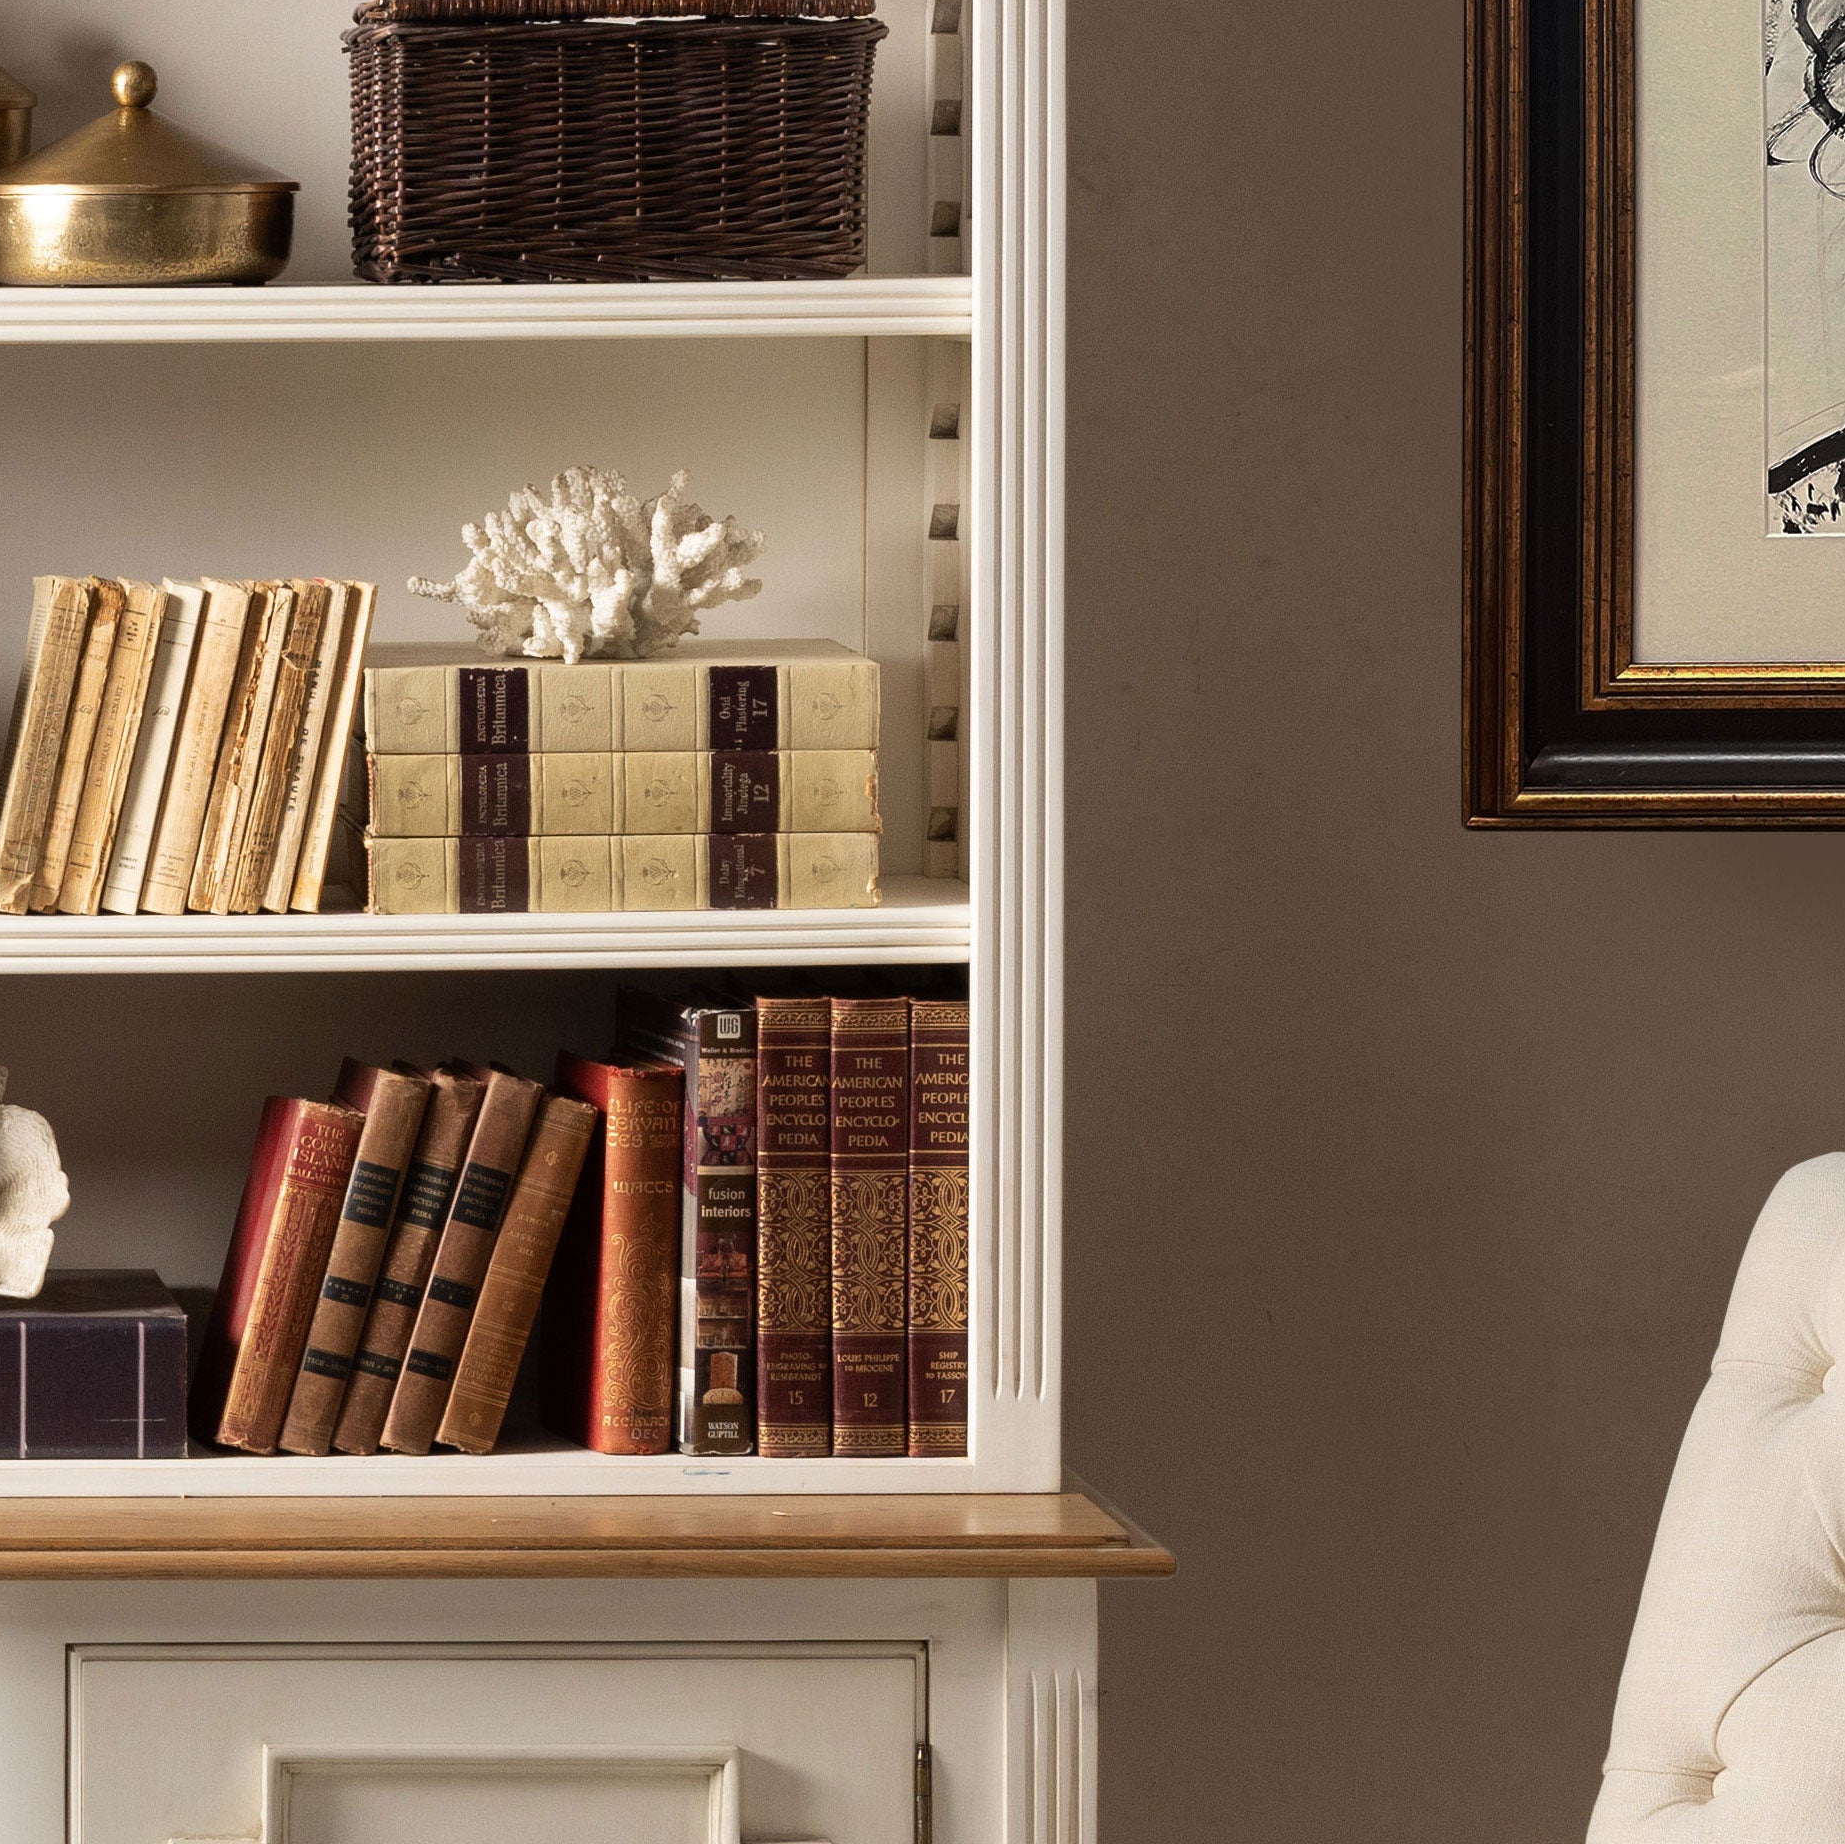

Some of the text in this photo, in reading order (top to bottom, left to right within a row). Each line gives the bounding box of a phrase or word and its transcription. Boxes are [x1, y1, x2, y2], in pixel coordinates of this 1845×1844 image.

[491, 673, 506, 745] Britannica
[719, 696, 731, 720] Ovid
[736, 681, 749, 732] Plastering
[753, 698, 768, 717] 17
[493, 762, 508, 826] Britannica
[721, 762, 735, 822] Immortality
[754, 784, 769, 802] 12
[491, 839, 506, 909] Britannica
[719, 1017, 739, 1034] WG
[785, 1056, 812, 1067] THE
[855, 1058, 882, 1069] THE
[937, 1054, 966, 1065] THE
[762, 1075, 828, 1087] AMERICAN
[832, 1077, 903, 1089] AMERICAN
[770, 1095, 825, 1106] PEOPLES
[839, 1096, 896, 1108] PEOPLES
[315, 1123, 344, 1139] THE
[778, 1133, 819, 1145] PEDIA
[848, 1135, 889, 1147] PEDIA
[931, 1132, 969, 1143] PEDIA
[301, 1135, 349, 1156] CORAL
[293, 1147, 351, 1171] ISLAND
[708, 1188, 745, 1200] fusion
[701, 1205, 751, 1217] interiors
[837, 1354, 862, 1362] LOUIS
[939, 1352, 959, 1360] SHIP
[856, 1364, 894, 1372] MIOCENE
[930, 1361, 968, 1370] REGISTRY
[788, 1391, 803, 1405] 15
[862, 1393, 878, 1407] 12
[940, 1390, 955, 1404] 17
